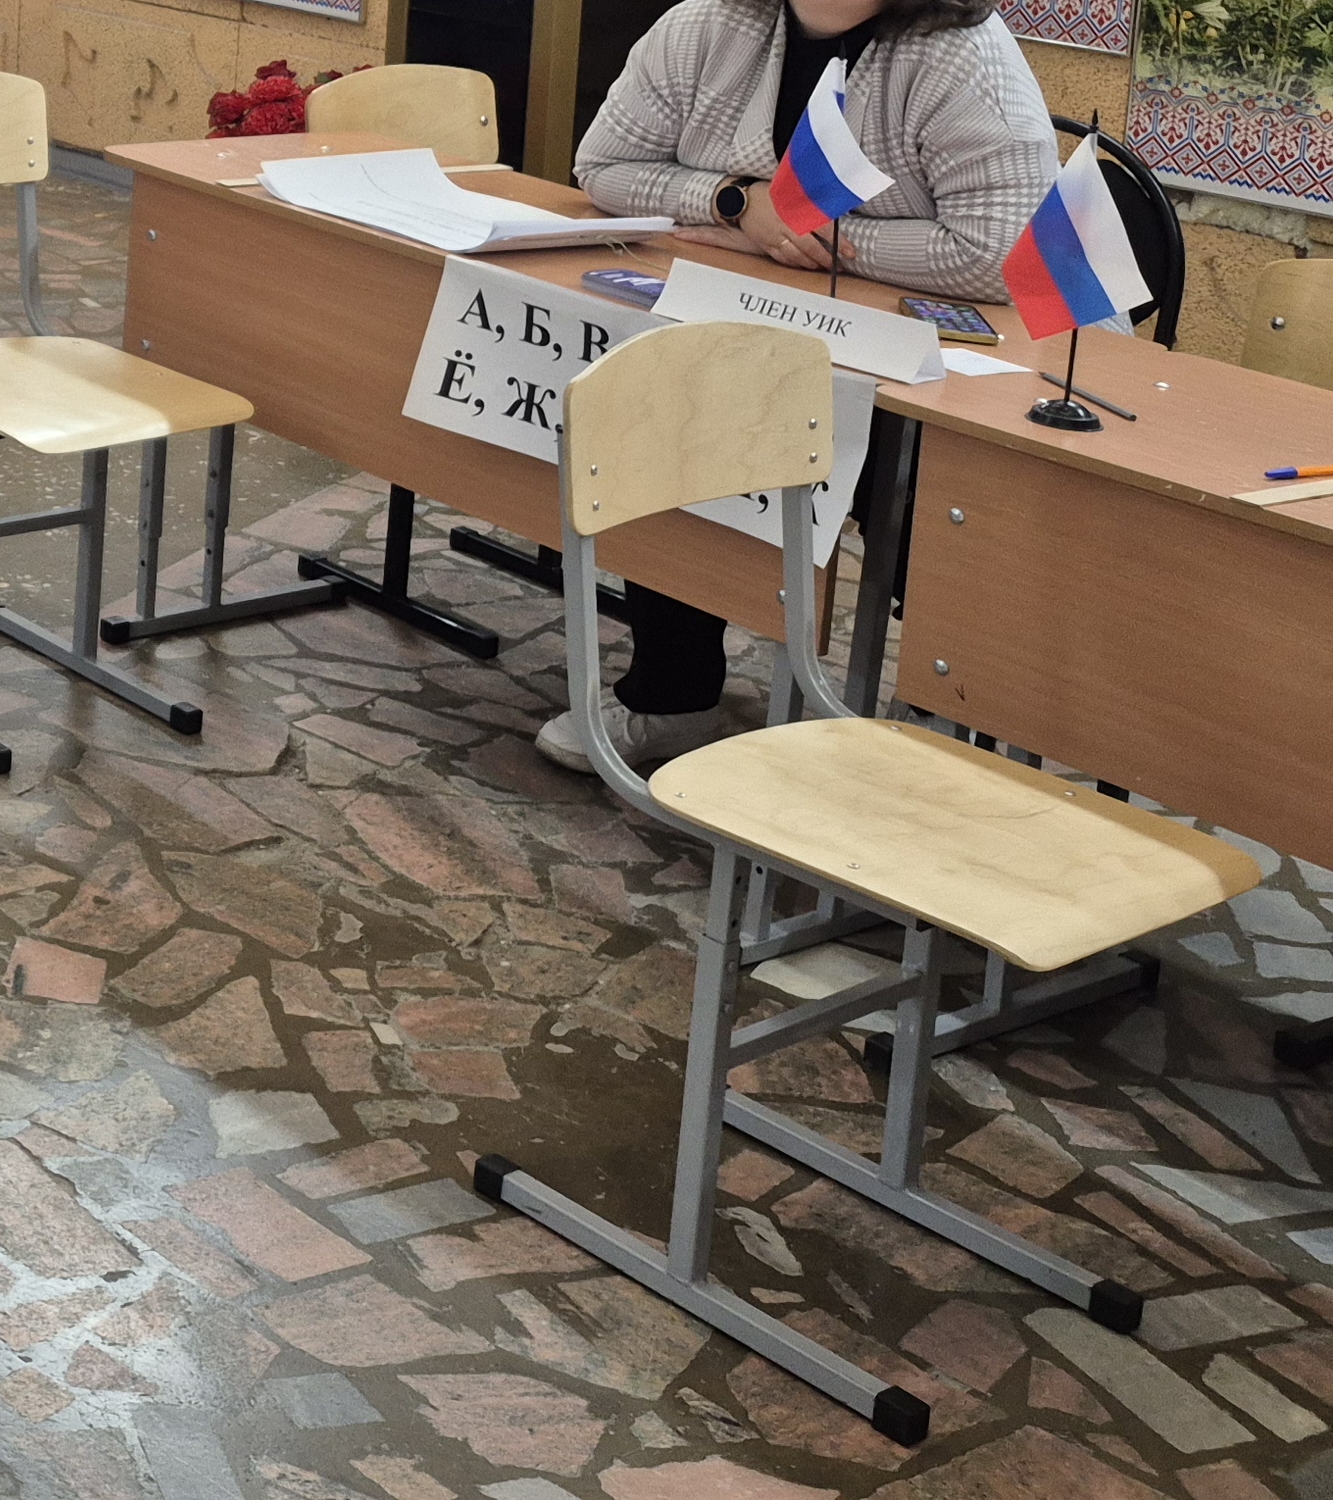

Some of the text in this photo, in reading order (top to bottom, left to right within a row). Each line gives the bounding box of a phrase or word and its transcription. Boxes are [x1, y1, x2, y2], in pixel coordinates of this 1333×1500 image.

[457, 288, 505, 343] А,
[519, 301, 562, 361] Б,
[740, 293, 852, 337] ЧЛЕН УИК
[435, 350, 485, 417] Ё,
